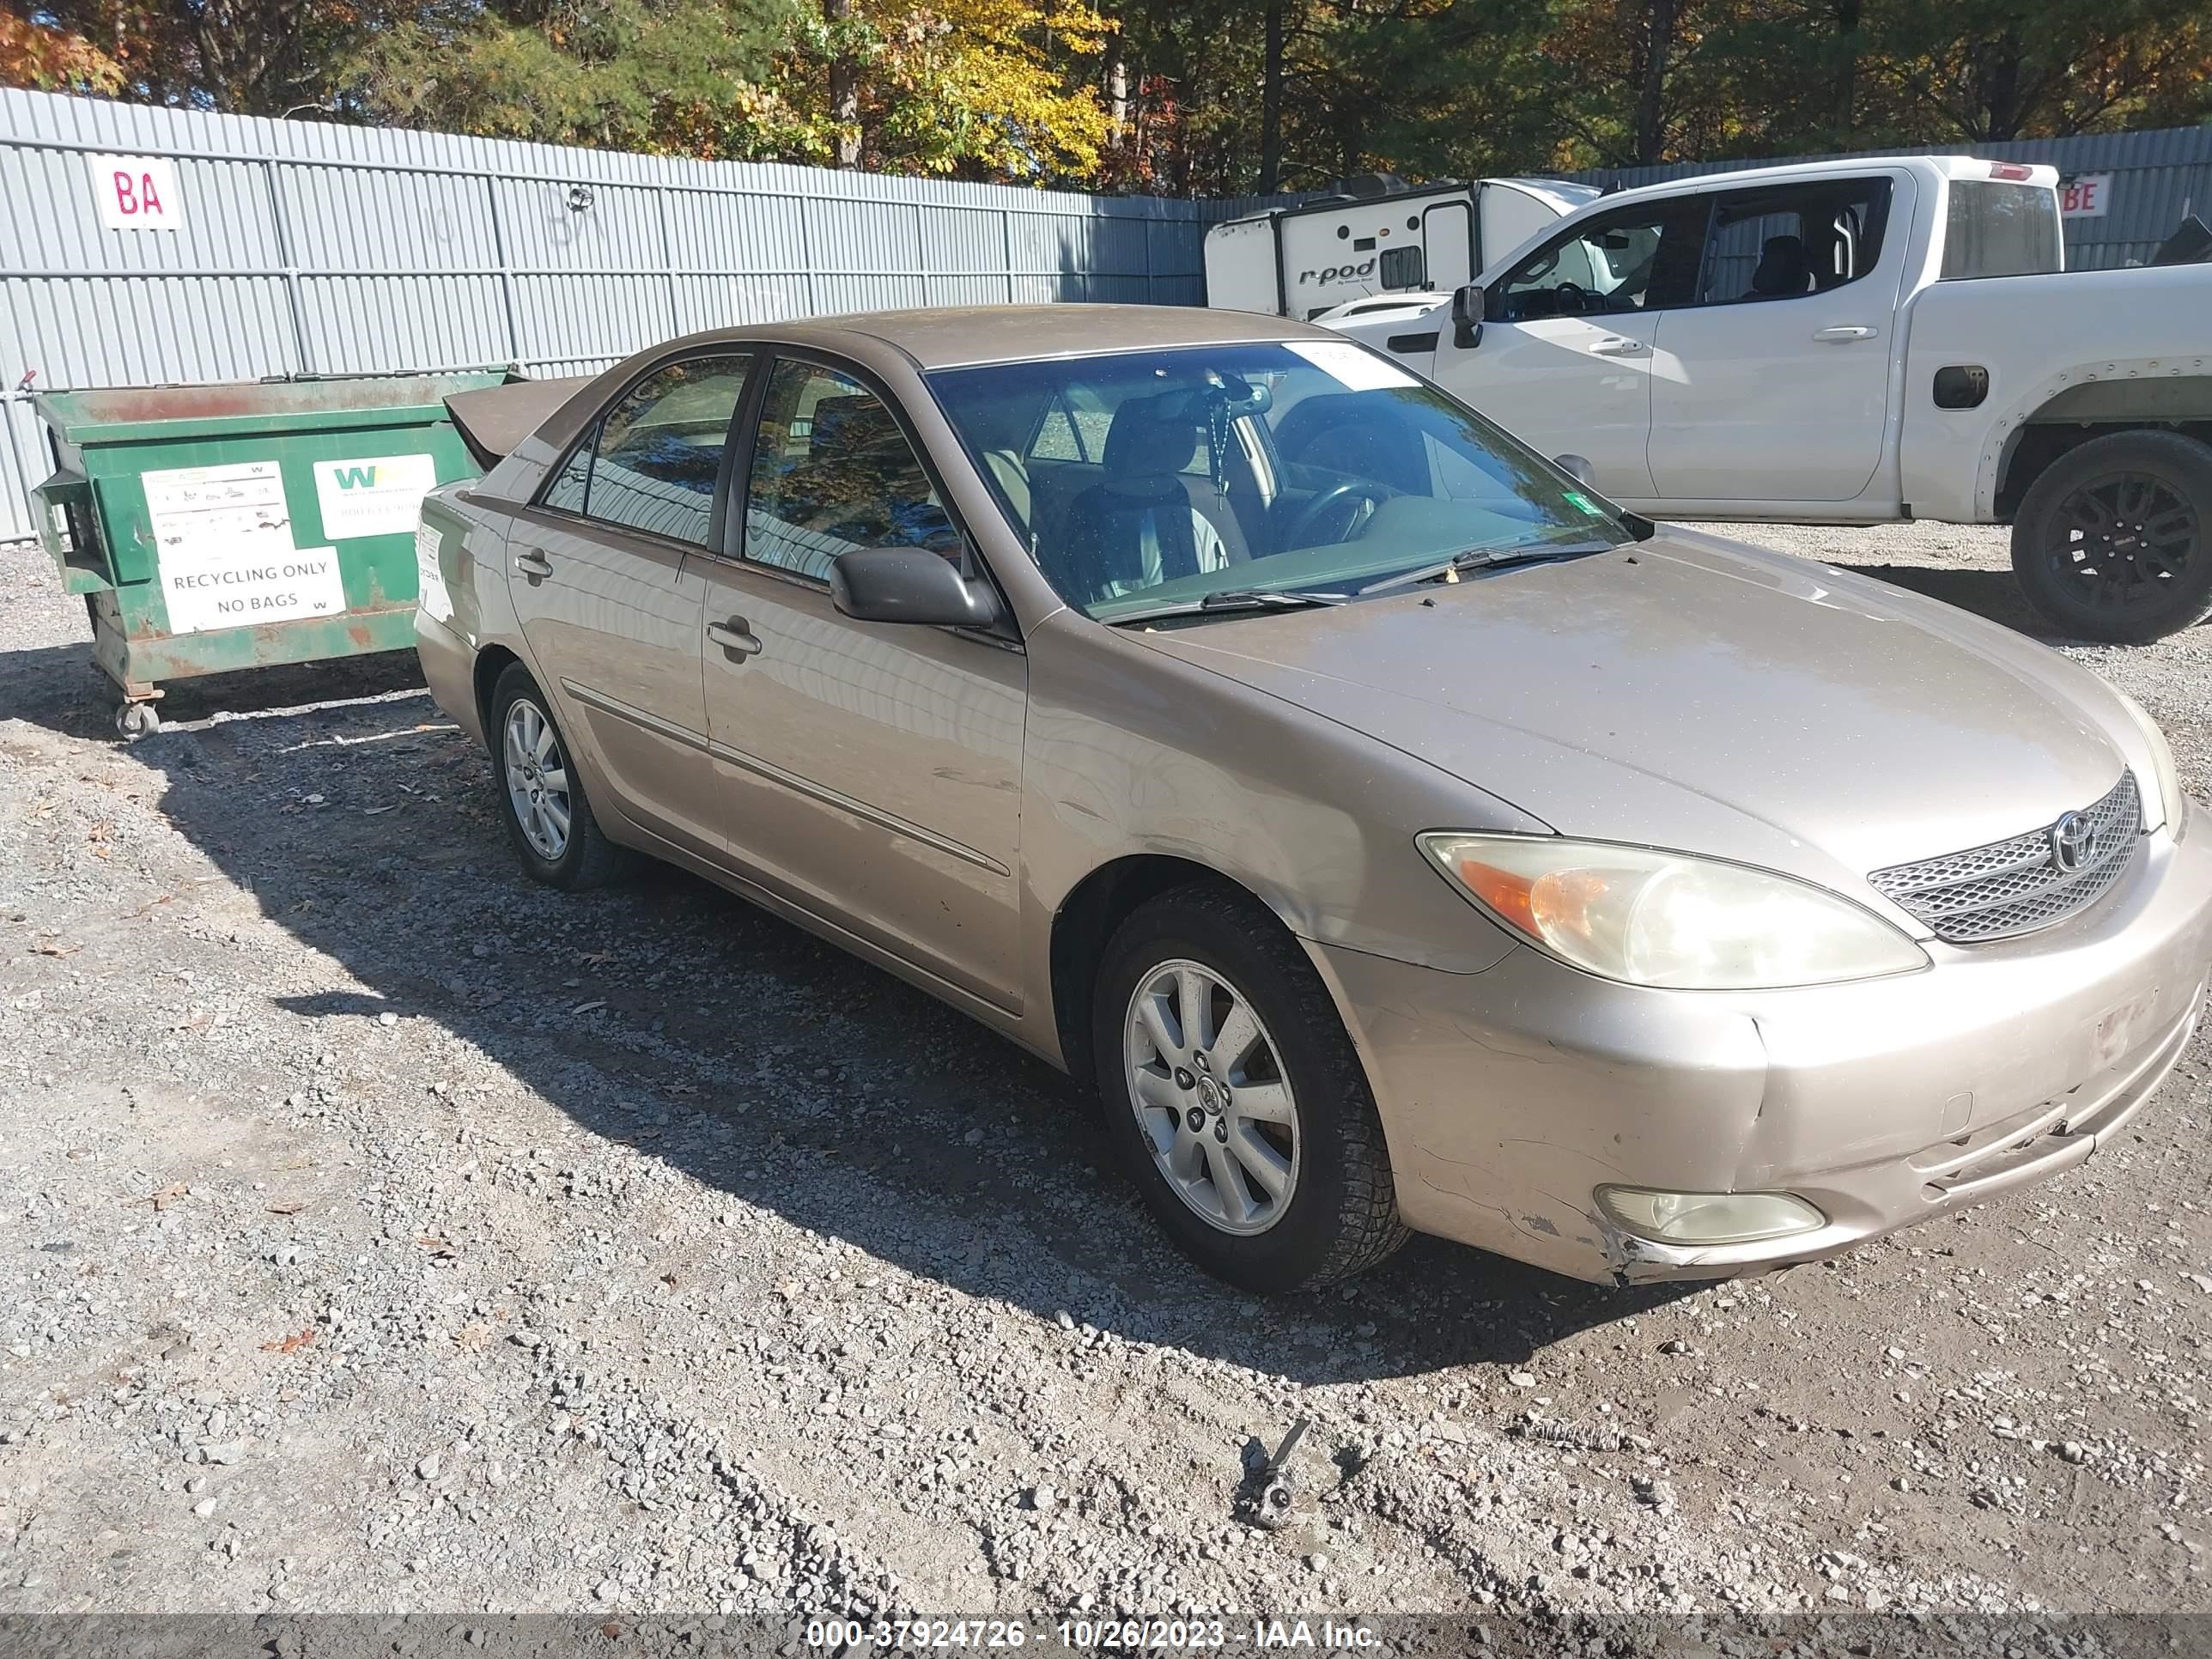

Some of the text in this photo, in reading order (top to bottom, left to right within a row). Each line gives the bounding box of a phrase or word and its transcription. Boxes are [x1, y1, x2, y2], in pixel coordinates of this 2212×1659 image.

[113, 171, 163, 215] BA
[2063, 182, 2097, 212] BE
[174, 562, 328, 590] RECYCLING ONLY
[218, 592, 298, 613] NO BAGS
